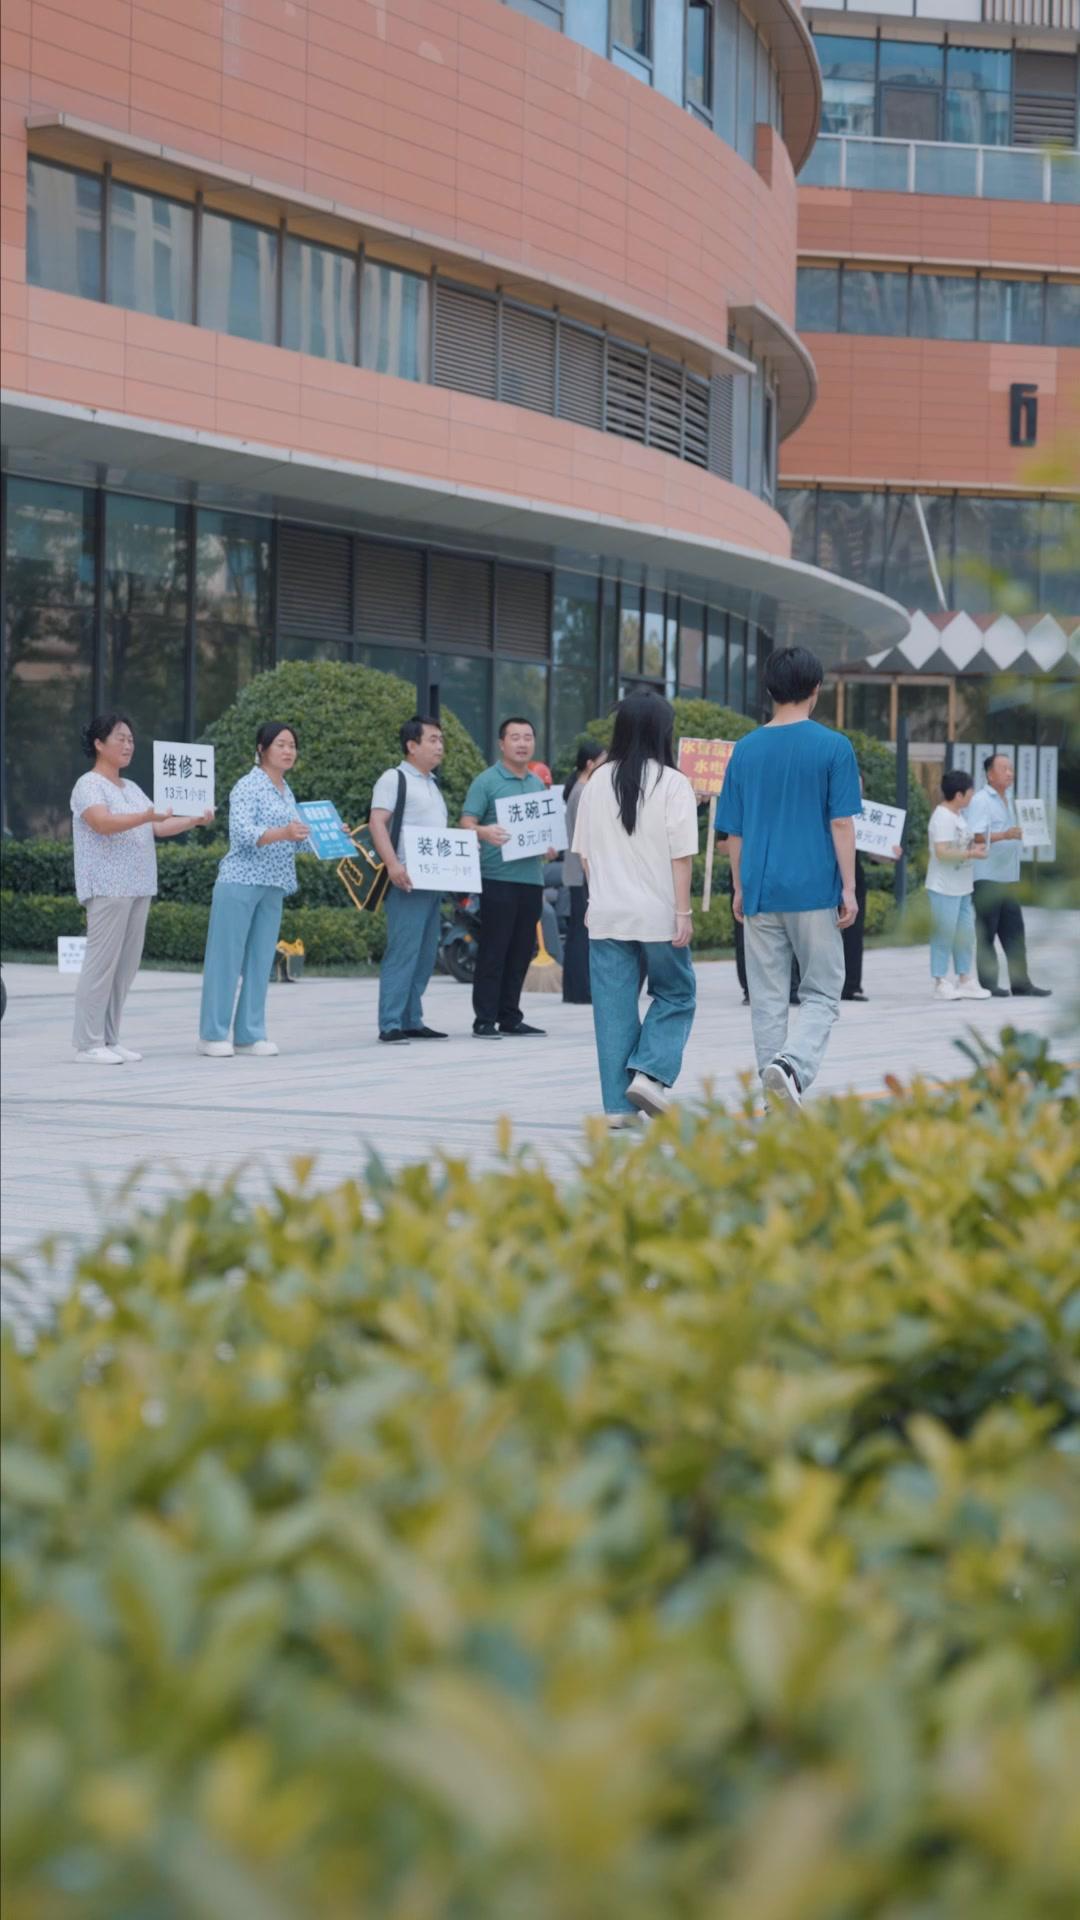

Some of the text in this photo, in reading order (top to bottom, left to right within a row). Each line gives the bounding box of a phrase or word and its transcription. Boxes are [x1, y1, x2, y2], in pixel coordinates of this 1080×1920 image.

[1009, 383, 1038, 448] 6
[163, 753, 208, 779] 维修工
[508, 798, 557, 823] 洗碗工
[417, 836, 471, 858] 装修工
